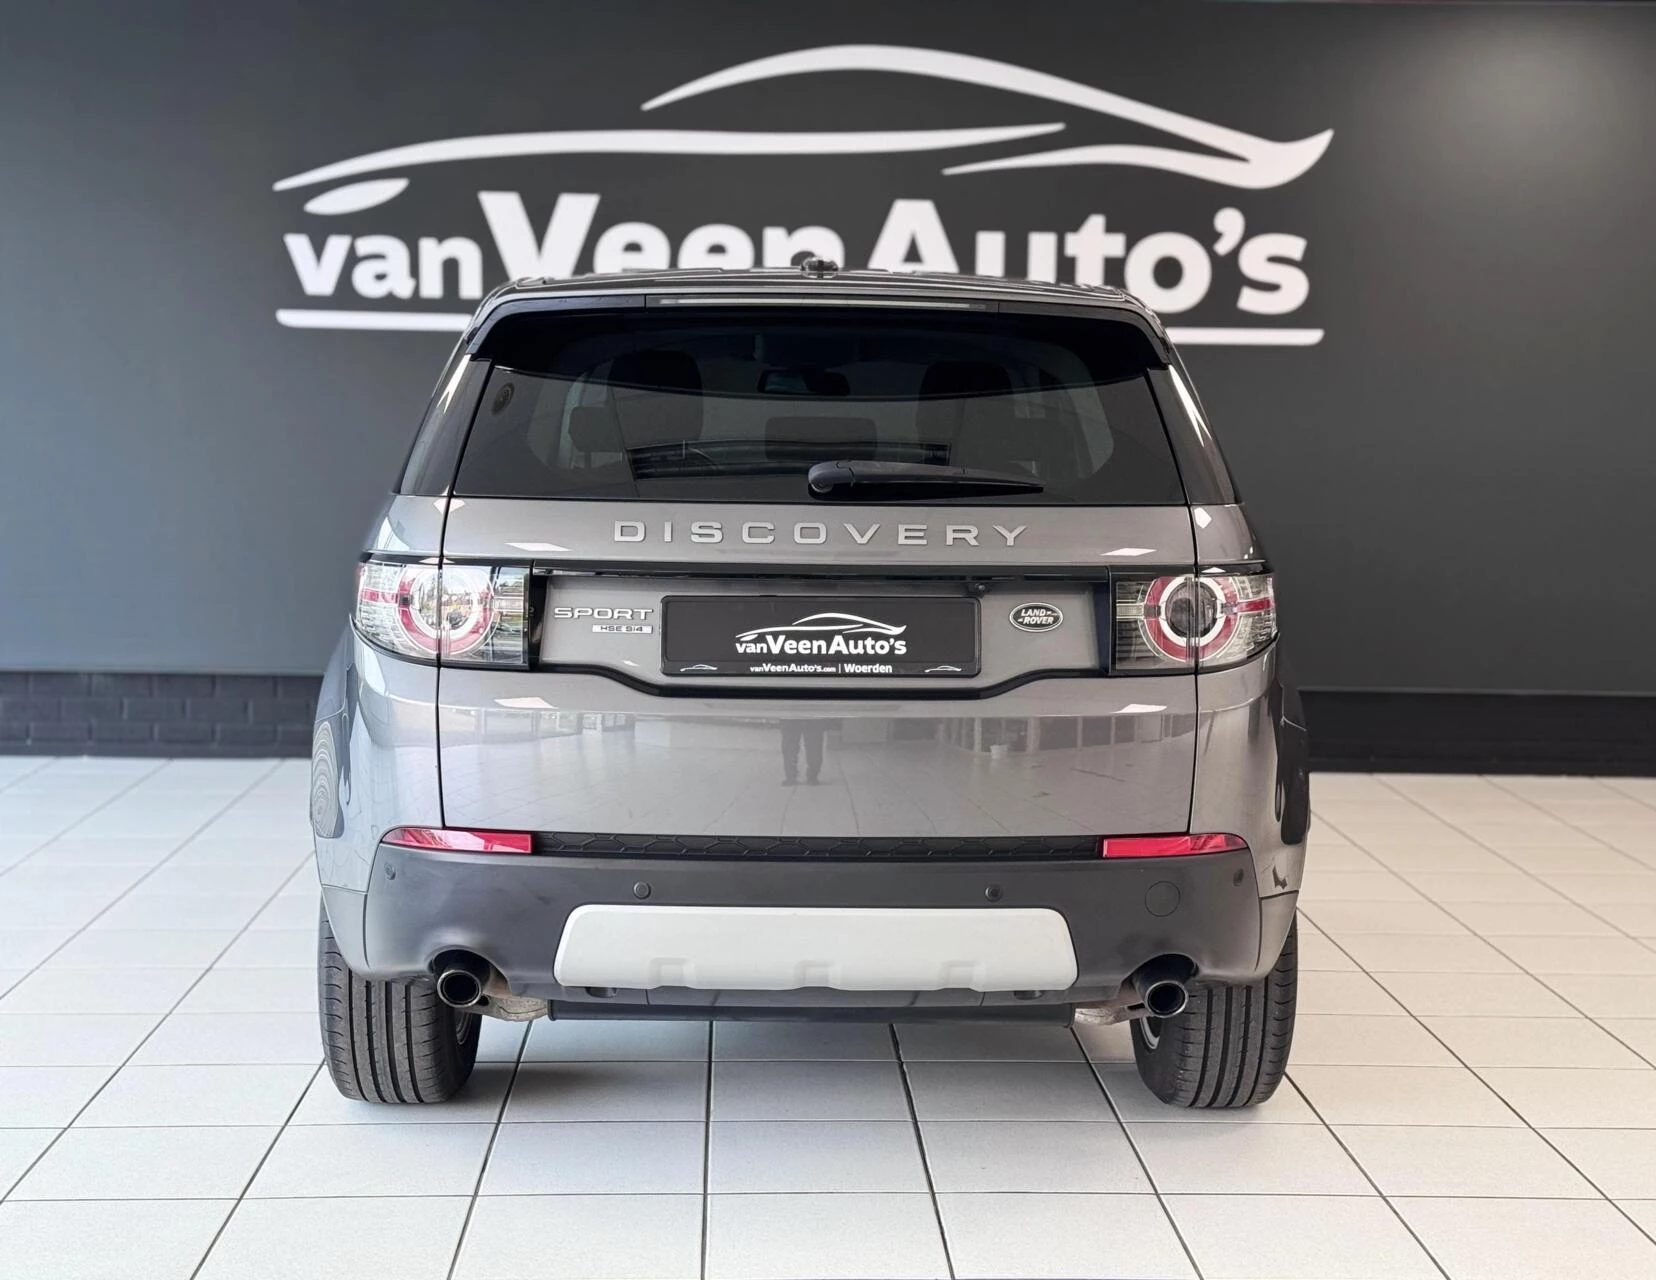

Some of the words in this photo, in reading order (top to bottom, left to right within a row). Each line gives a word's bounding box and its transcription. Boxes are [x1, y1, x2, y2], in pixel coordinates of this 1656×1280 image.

[613, 520, 1028, 547] DISCOVERY
[553, 607, 653, 620] SPORT
[1021, 608, 1046, 616] LAND
[1022, 616, 1054, 625] ROVER
[600, 624, 623, 632] HSE
[735, 634, 907, 656] vanVeenAuto's
[843, 662, 893, 674] Woerden
